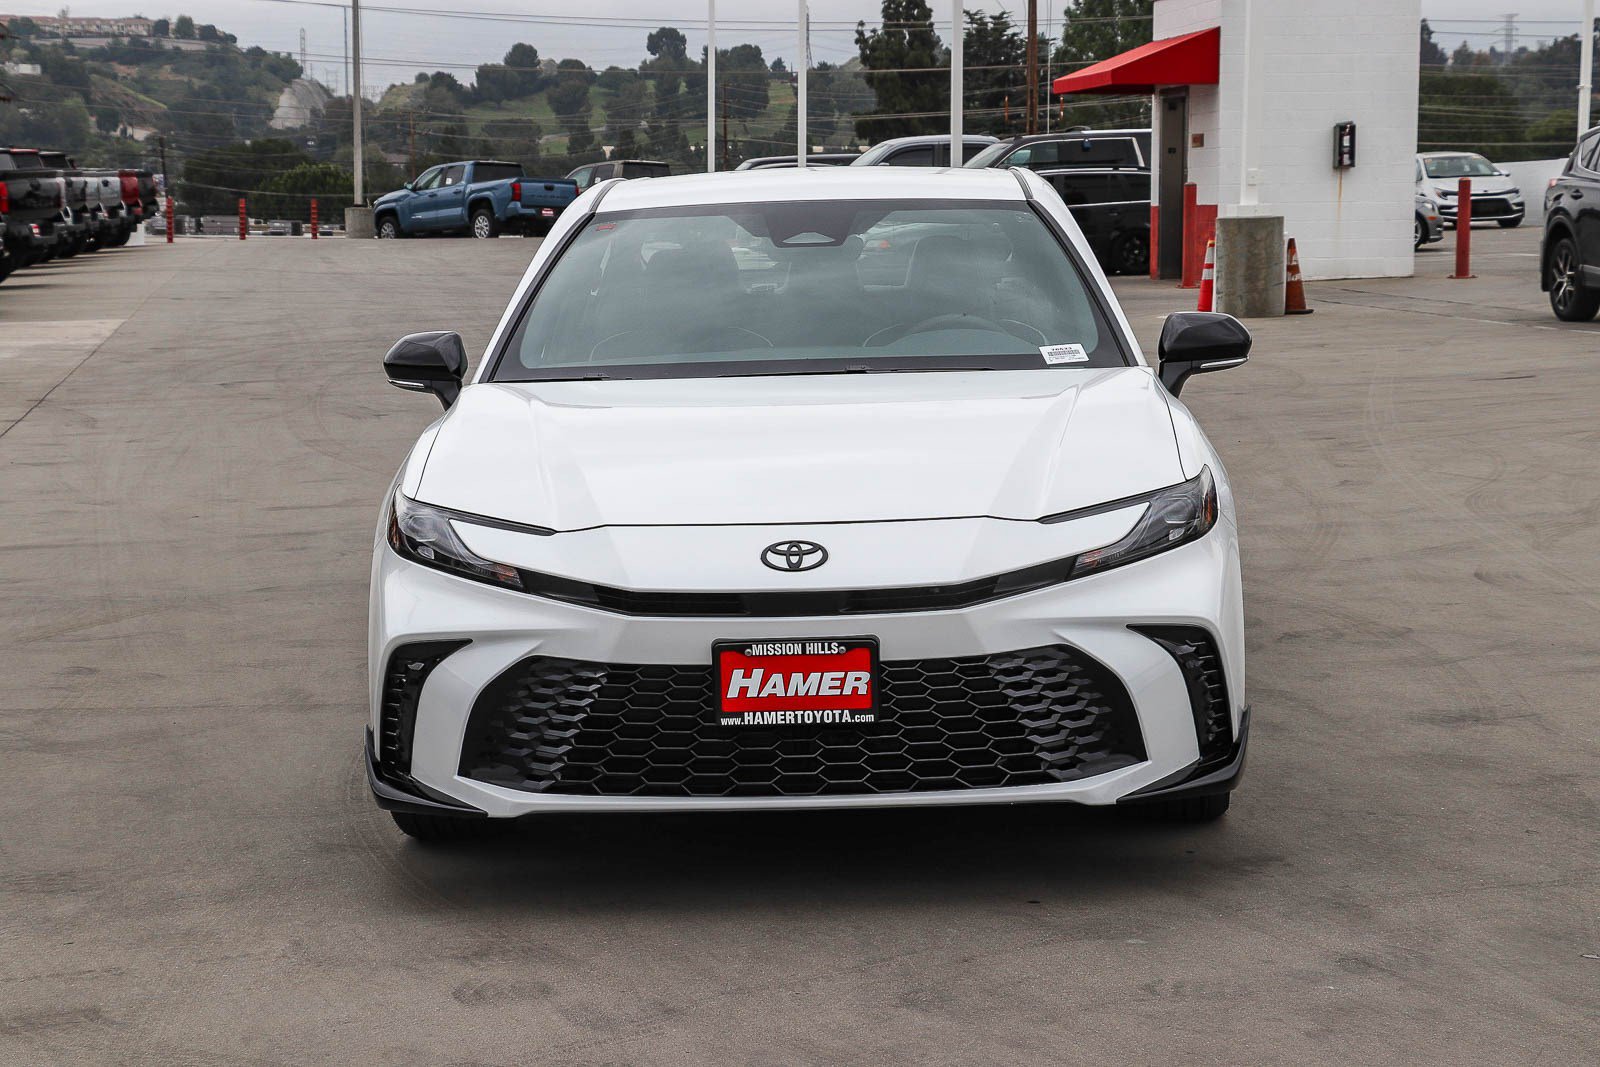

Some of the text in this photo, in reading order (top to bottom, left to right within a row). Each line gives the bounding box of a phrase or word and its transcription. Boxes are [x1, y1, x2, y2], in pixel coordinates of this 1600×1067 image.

[752, 642, 839, 656] MISSION HILLS
[726, 668, 871, 698] HAMER
[720, 710, 875, 726] www.HAMERTOYOTA.com
